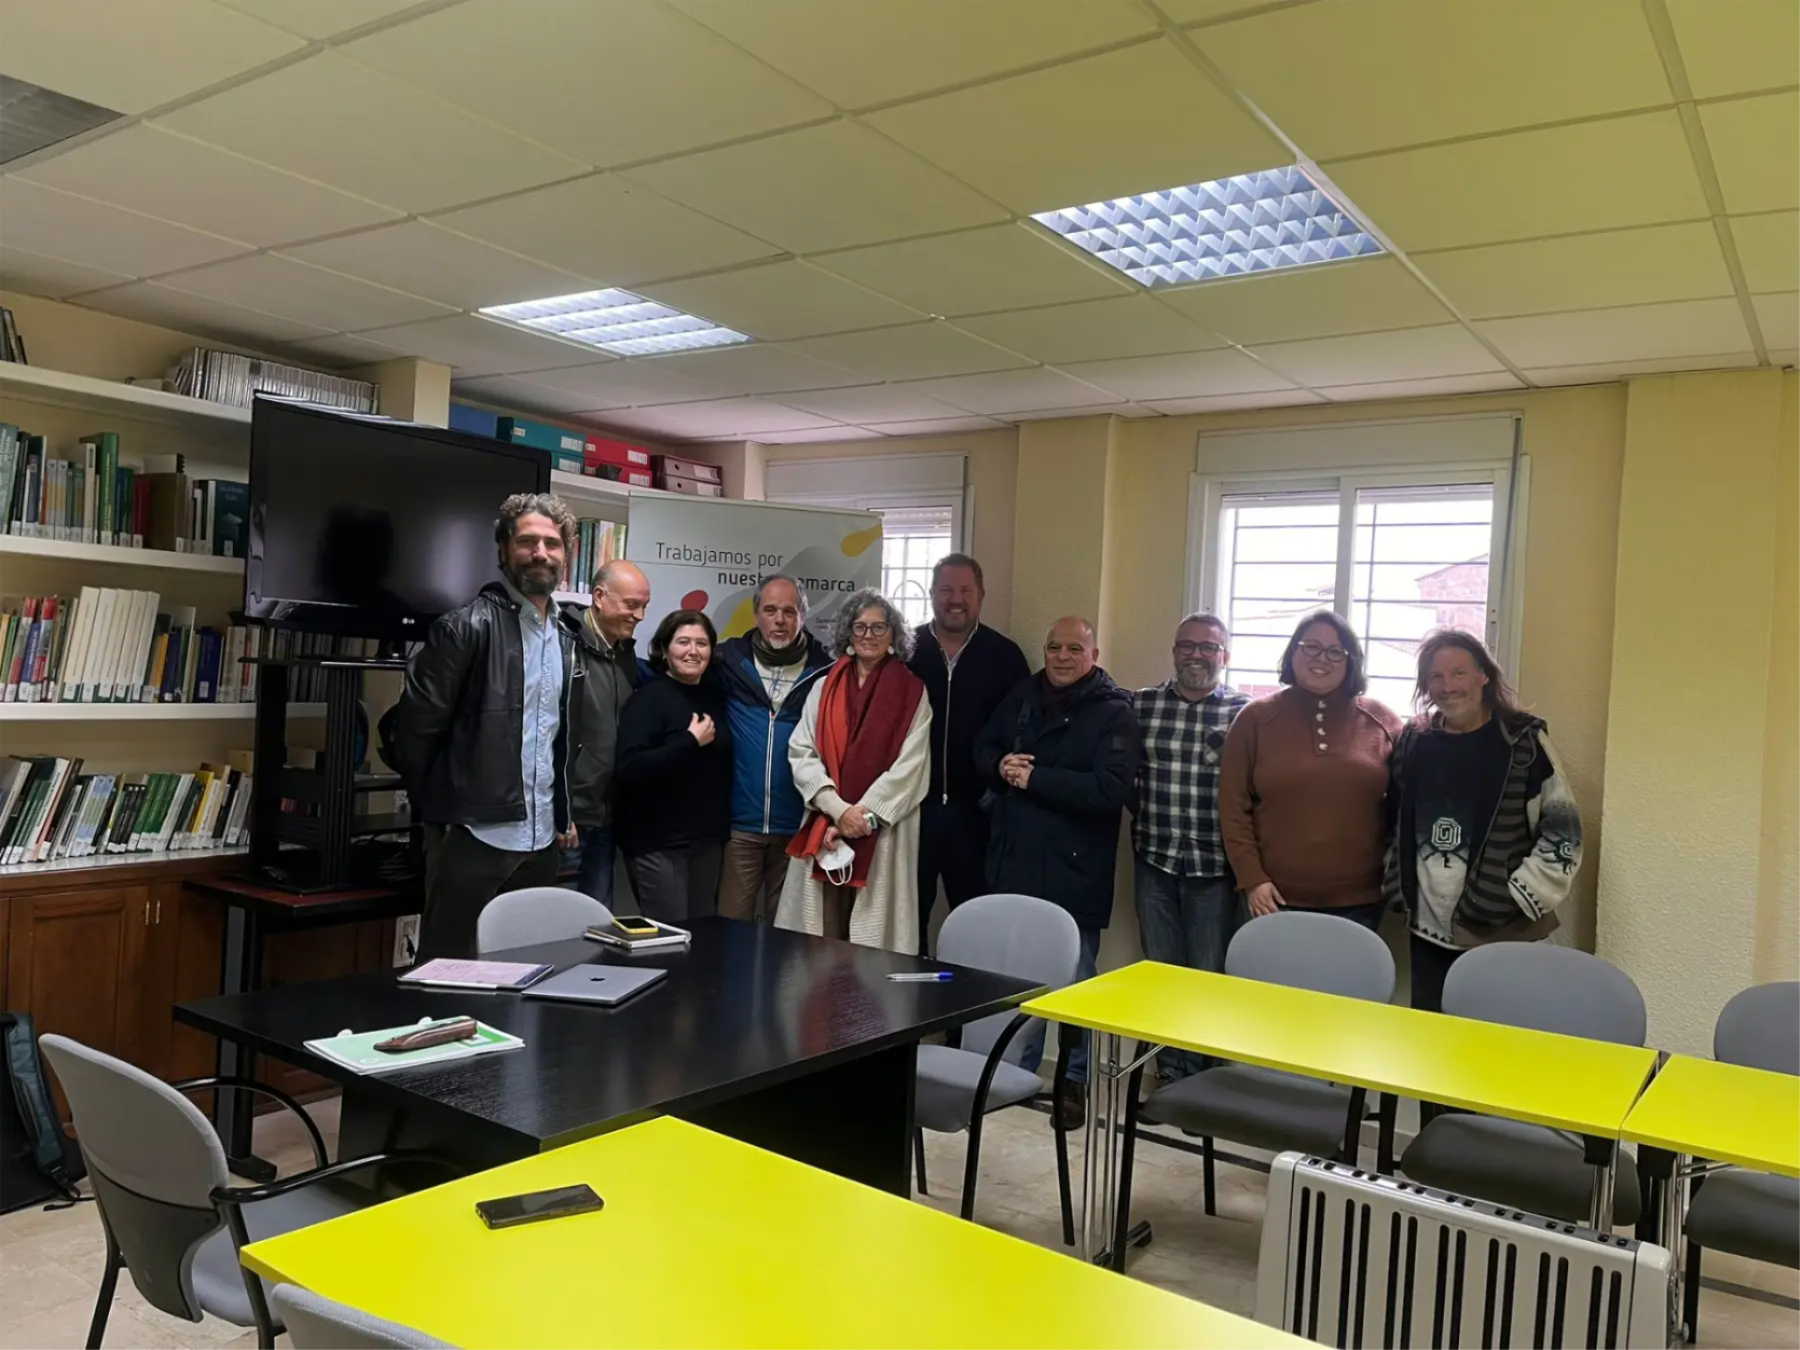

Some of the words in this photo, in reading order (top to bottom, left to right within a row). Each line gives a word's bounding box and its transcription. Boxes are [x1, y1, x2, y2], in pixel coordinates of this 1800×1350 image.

[656, 541, 752, 566] Trabajamos
[758, 553, 784, 570] por
[718, 571, 765, 587] nuest
[797, 577, 856, 593] marca
